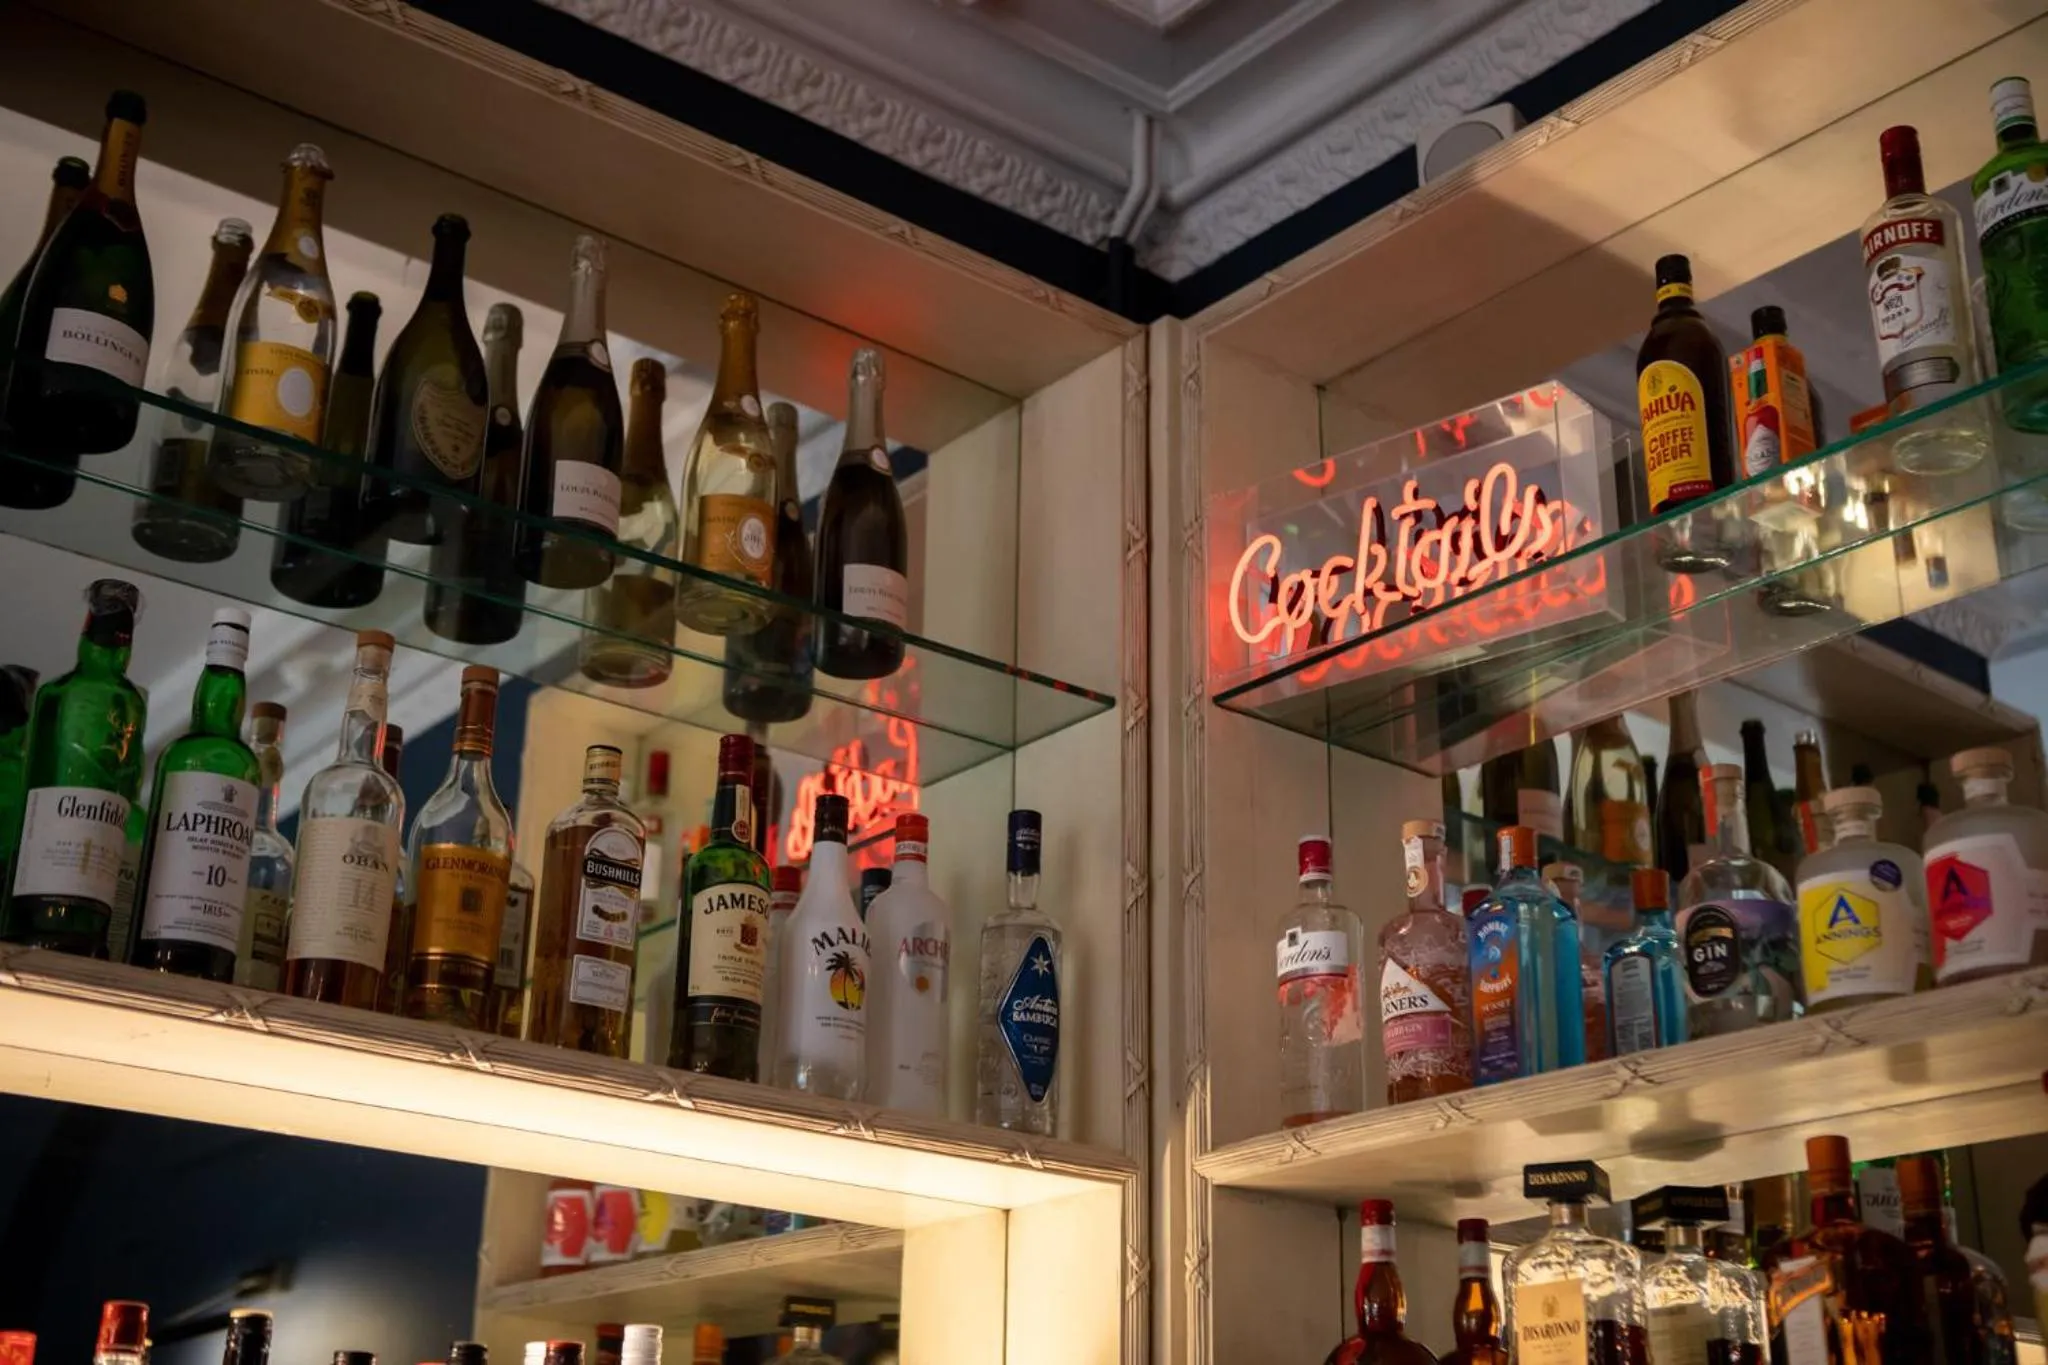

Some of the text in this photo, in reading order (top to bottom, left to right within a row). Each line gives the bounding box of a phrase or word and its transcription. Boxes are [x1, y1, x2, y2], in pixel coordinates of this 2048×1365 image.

[1864, 222, 1933, 260] IRNOFF
[1647, 426, 1694, 455] COFFEE
[1648, 443, 1692, 473] QUEUR
[1230, 463, 1553, 646] Cocktails
[342, 853, 390, 874] OBAN
[586, 860, 641, 885] BUSHMILLS
[206, 864, 227, 888] 10
[1693, 942, 1728, 962] GIN
[1528, 1169, 1588, 1186] DISARONNO
[1522, 1319, 1582, 1342] DISARONNO
